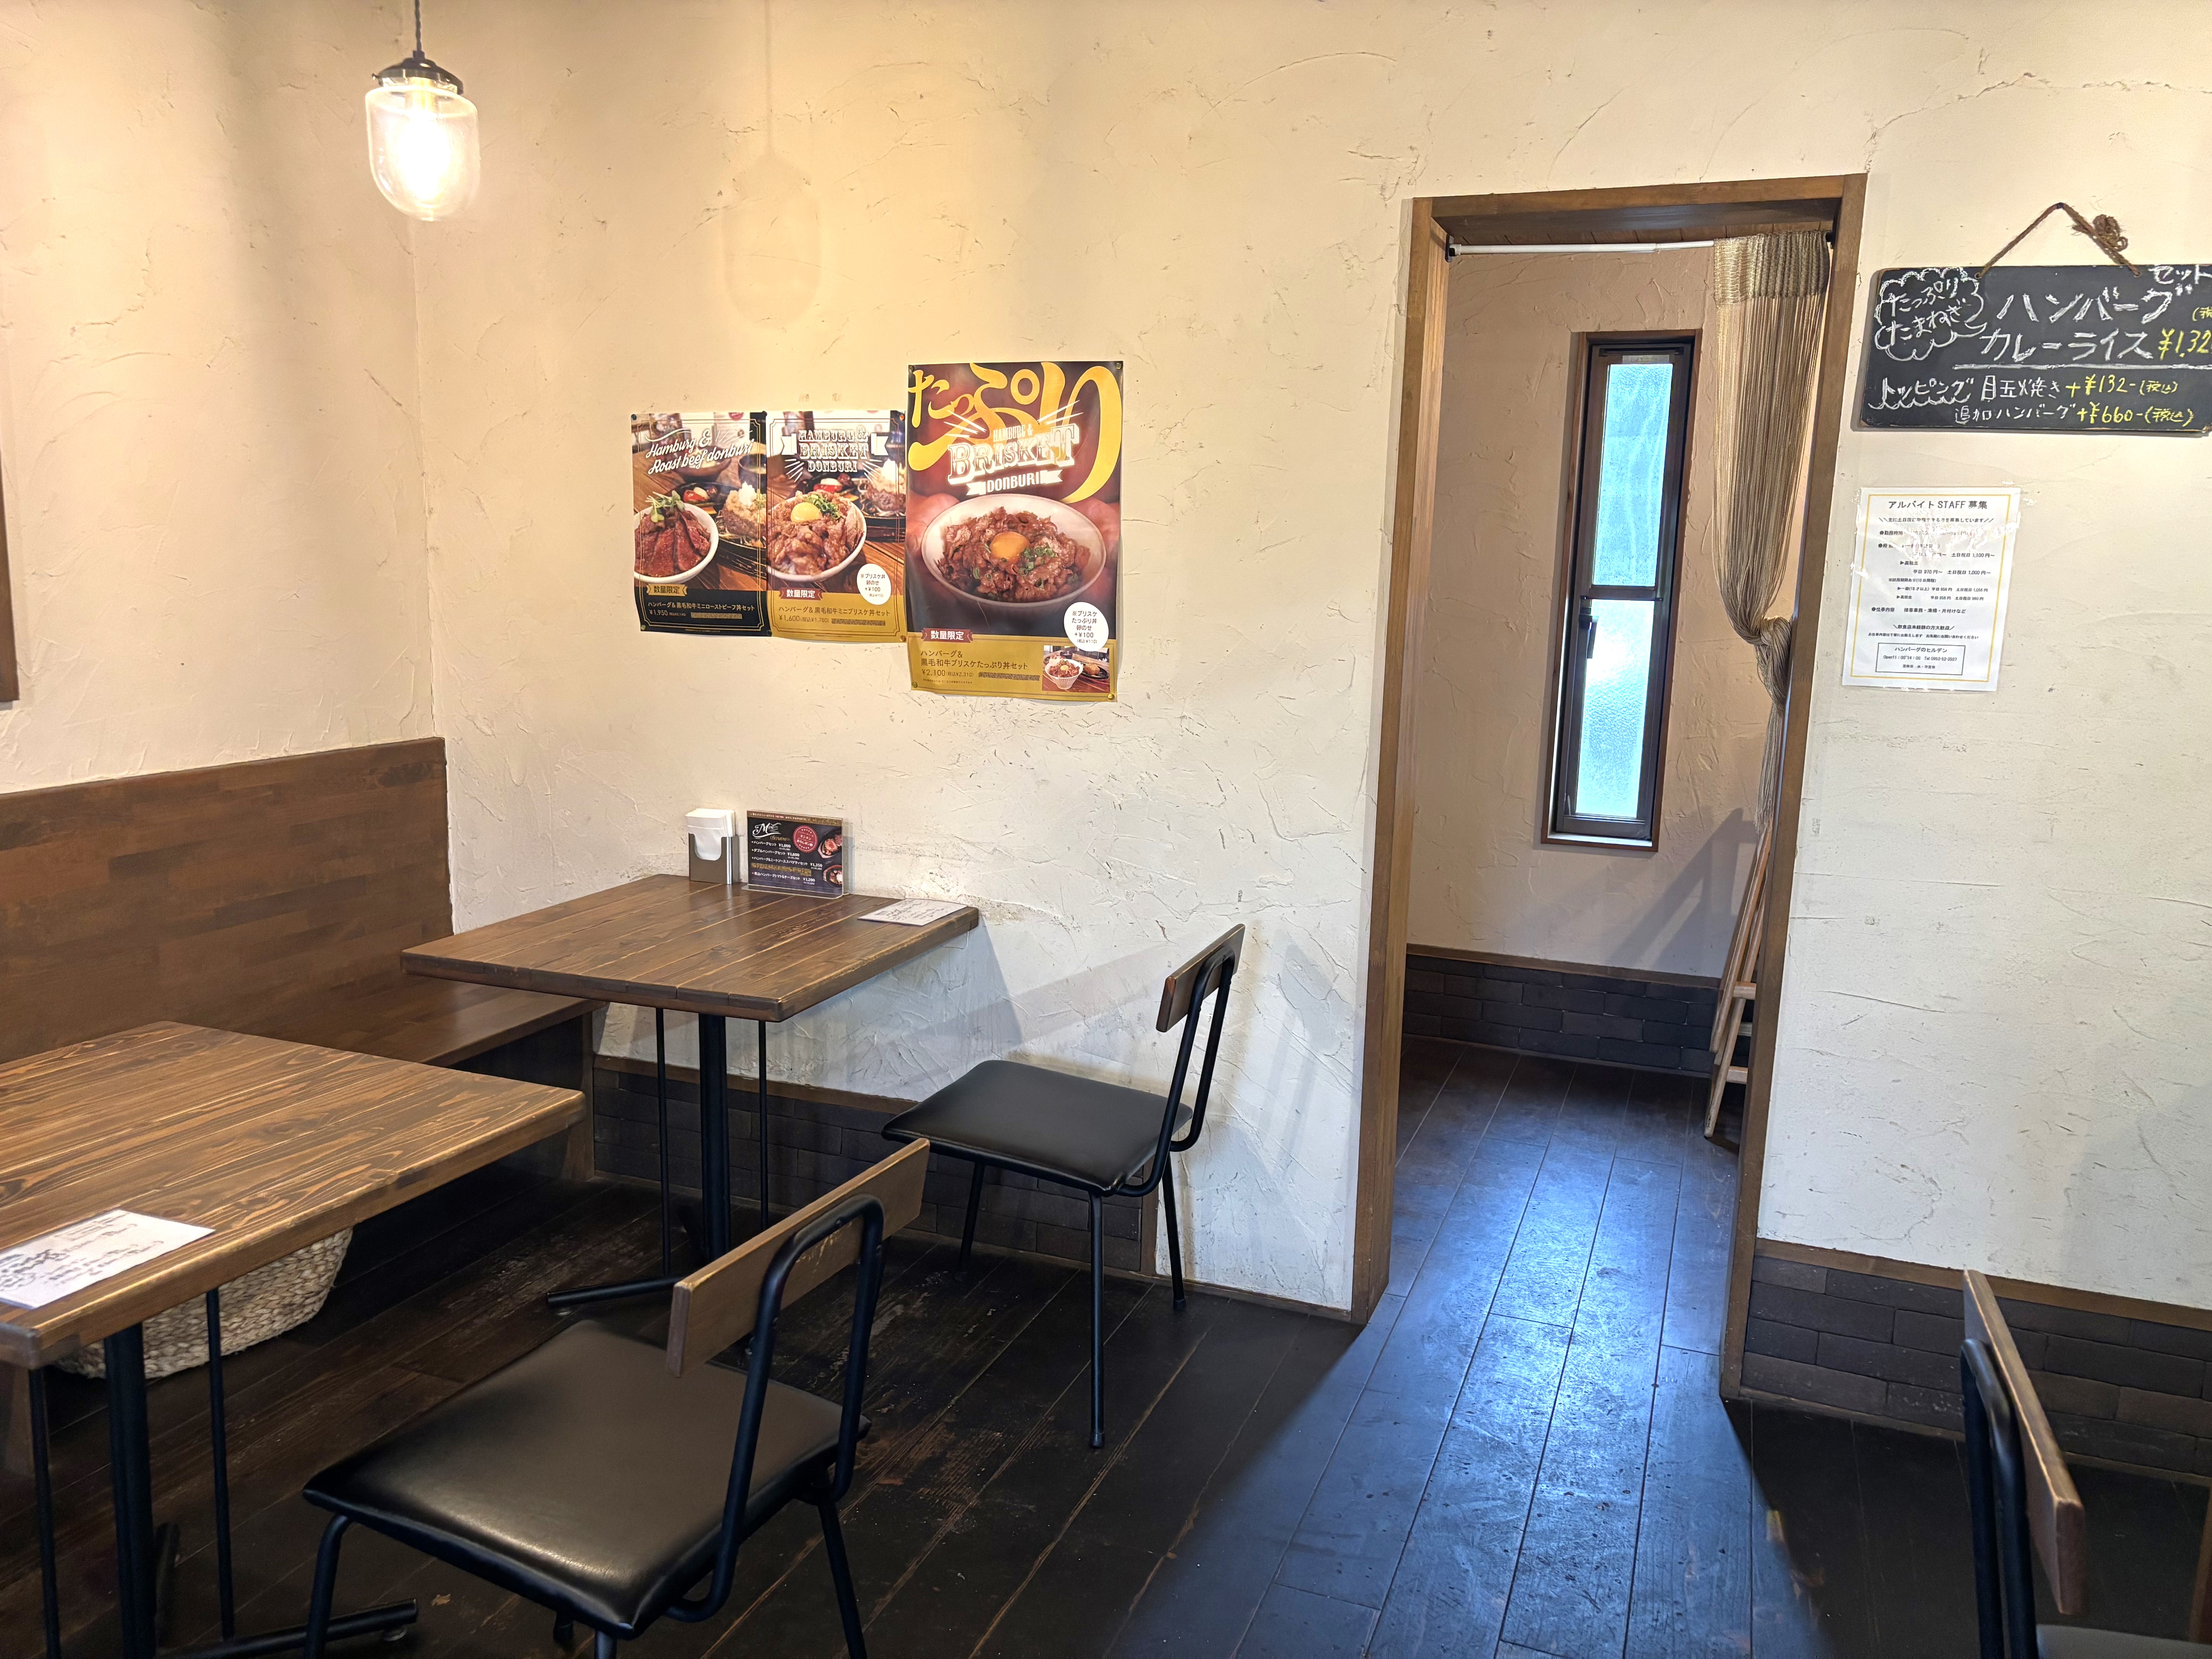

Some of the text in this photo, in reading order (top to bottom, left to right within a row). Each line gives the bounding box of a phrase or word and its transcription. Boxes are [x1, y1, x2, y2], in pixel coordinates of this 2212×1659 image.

[1996, 286, 2192, 325] ハンバーグ
[1885, 298, 1966, 346] たまねぎ
[1979, 328, 2154, 362] カレーライス
[1882, 377, 1975, 400] トッピング
[1954, 403, 2076, 426] 追加ハンバーグ
[645, 429, 712, 459] Hamburg &
[798, 424, 869, 442] HAMBURG &
[993, 424, 1026, 443] HAMBURG
[647, 438, 755, 475] Roast beef donburi
[799, 442, 869, 460] BRISKET
[947, 422, 1080, 485] BRISKET
[807, 460, 858, 472] DONBURI
[987, 471, 1041, 493] DONBURI
[1888, 500, 1934, 509] アルバイト
[1968, 500, 1987, 510] 募集
[654, 586, 680, 594] 数量限定
[787, 589, 816, 599] 数量限定
[931, 630, 964, 641] 数量限定
